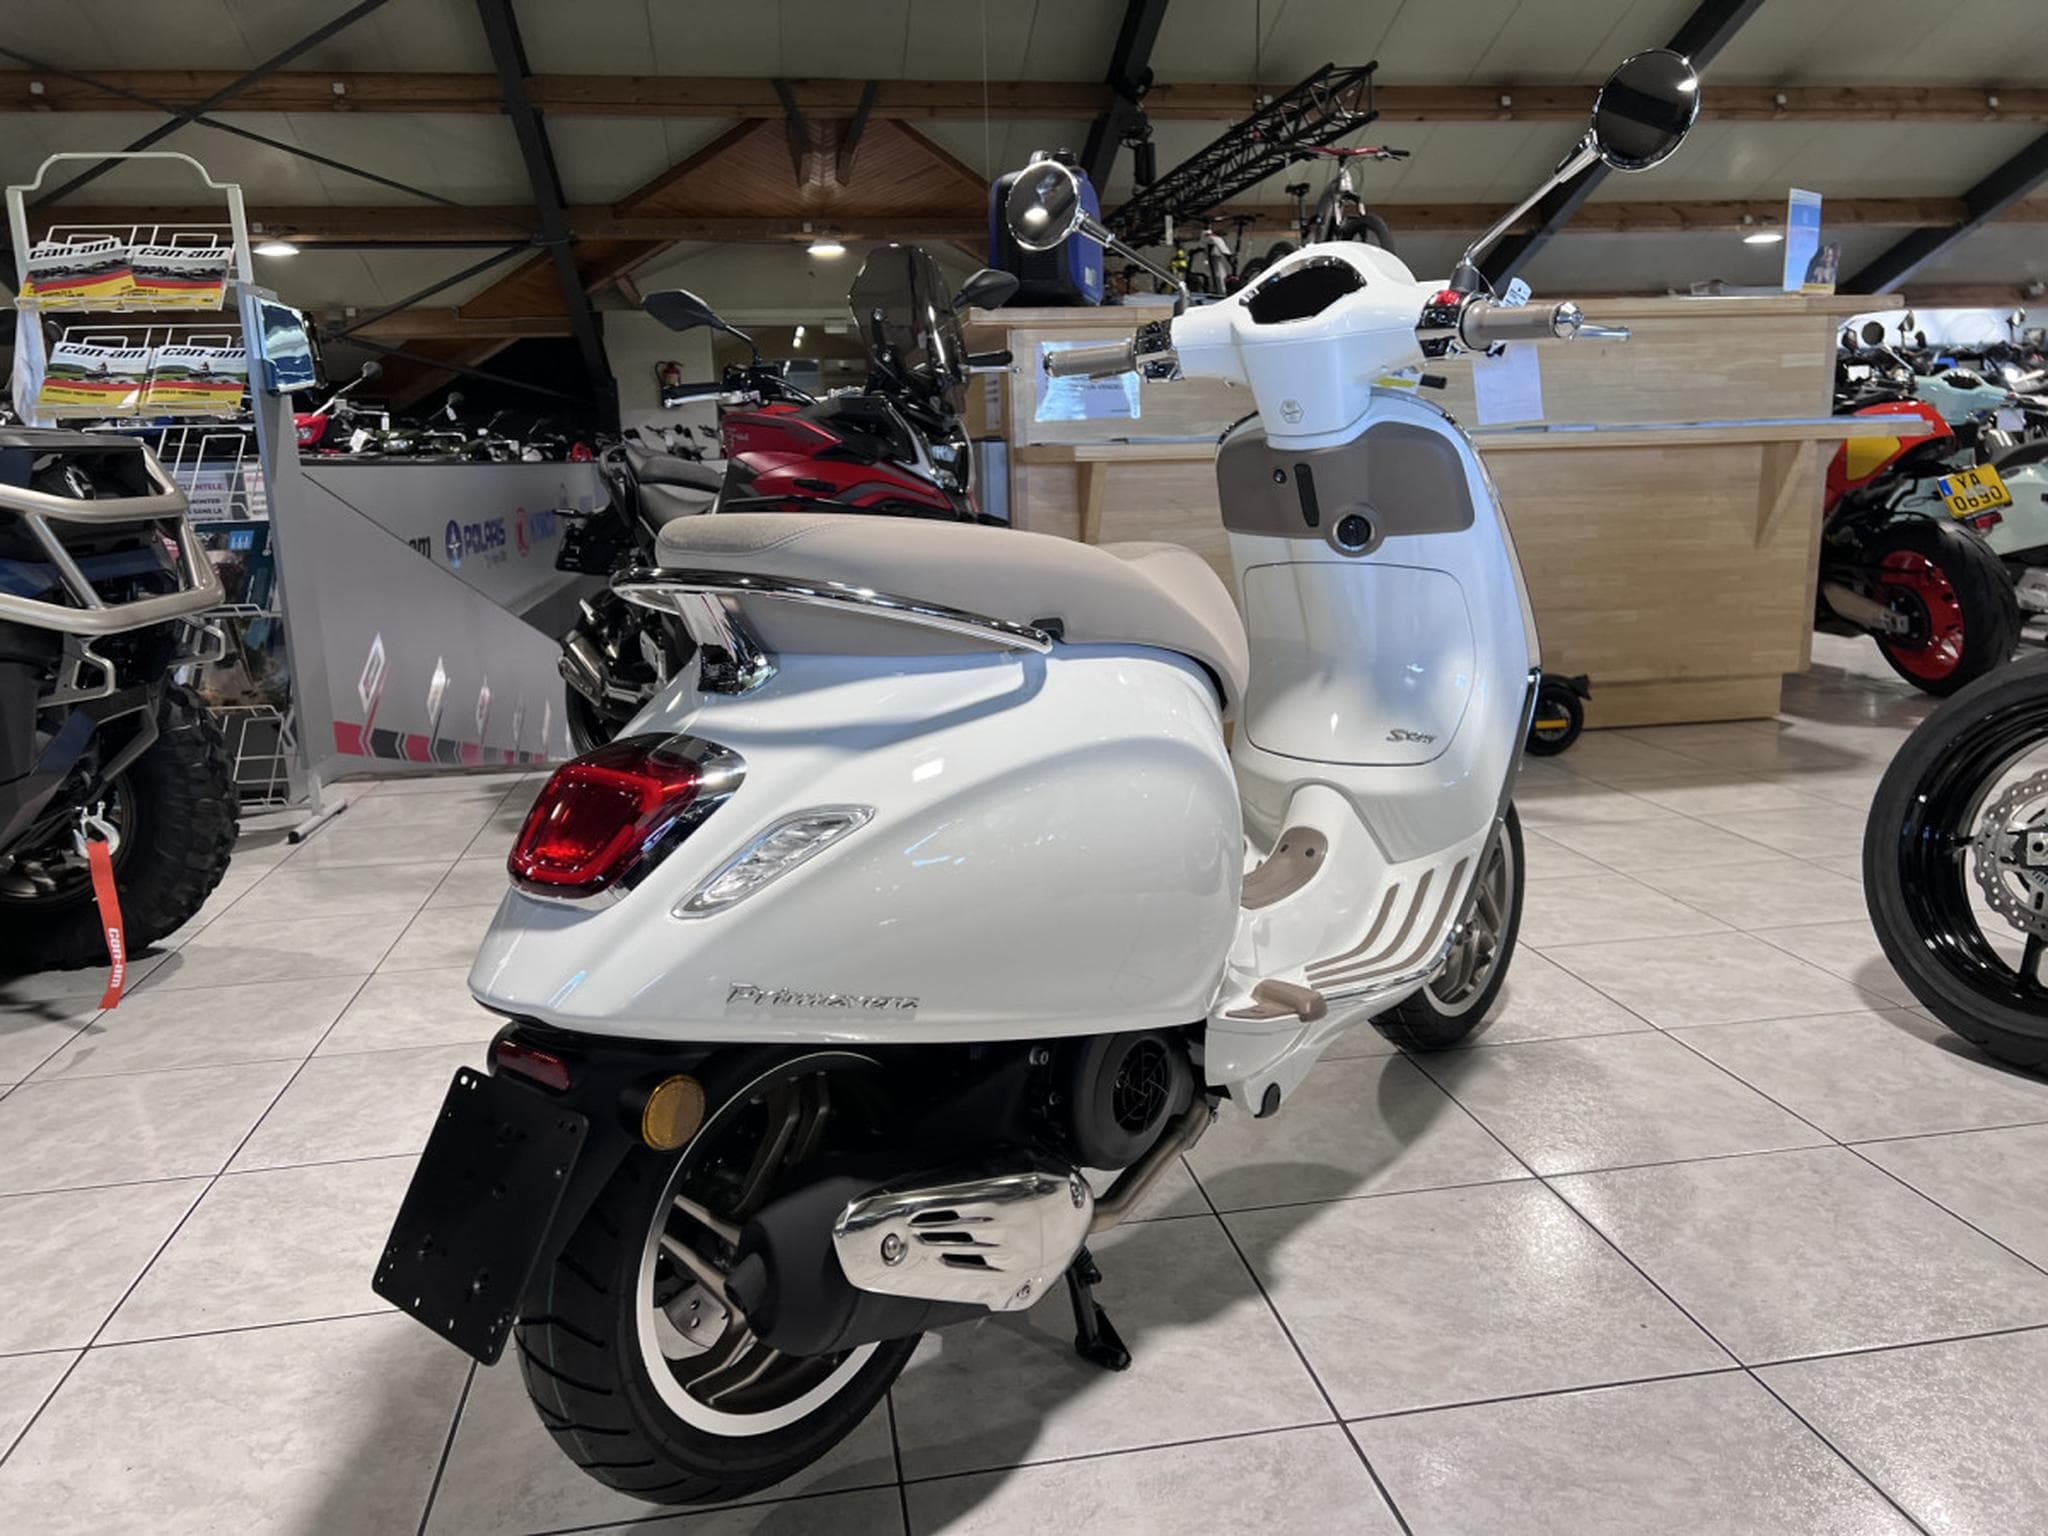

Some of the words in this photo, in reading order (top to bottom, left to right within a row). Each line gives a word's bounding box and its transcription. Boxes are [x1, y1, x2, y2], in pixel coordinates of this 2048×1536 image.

[29, 240, 117, 260] can-am
[138, 247, 225, 258] can-am
[58, 345, 146, 359] can-am
[162, 346, 246, 359] can-am
[1956, 473, 1981, 488] YA
[463, 518, 506, 555] POLARIS
[108, 928, 124, 988] can-am
[726, 982, 921, 1009] Primavera
